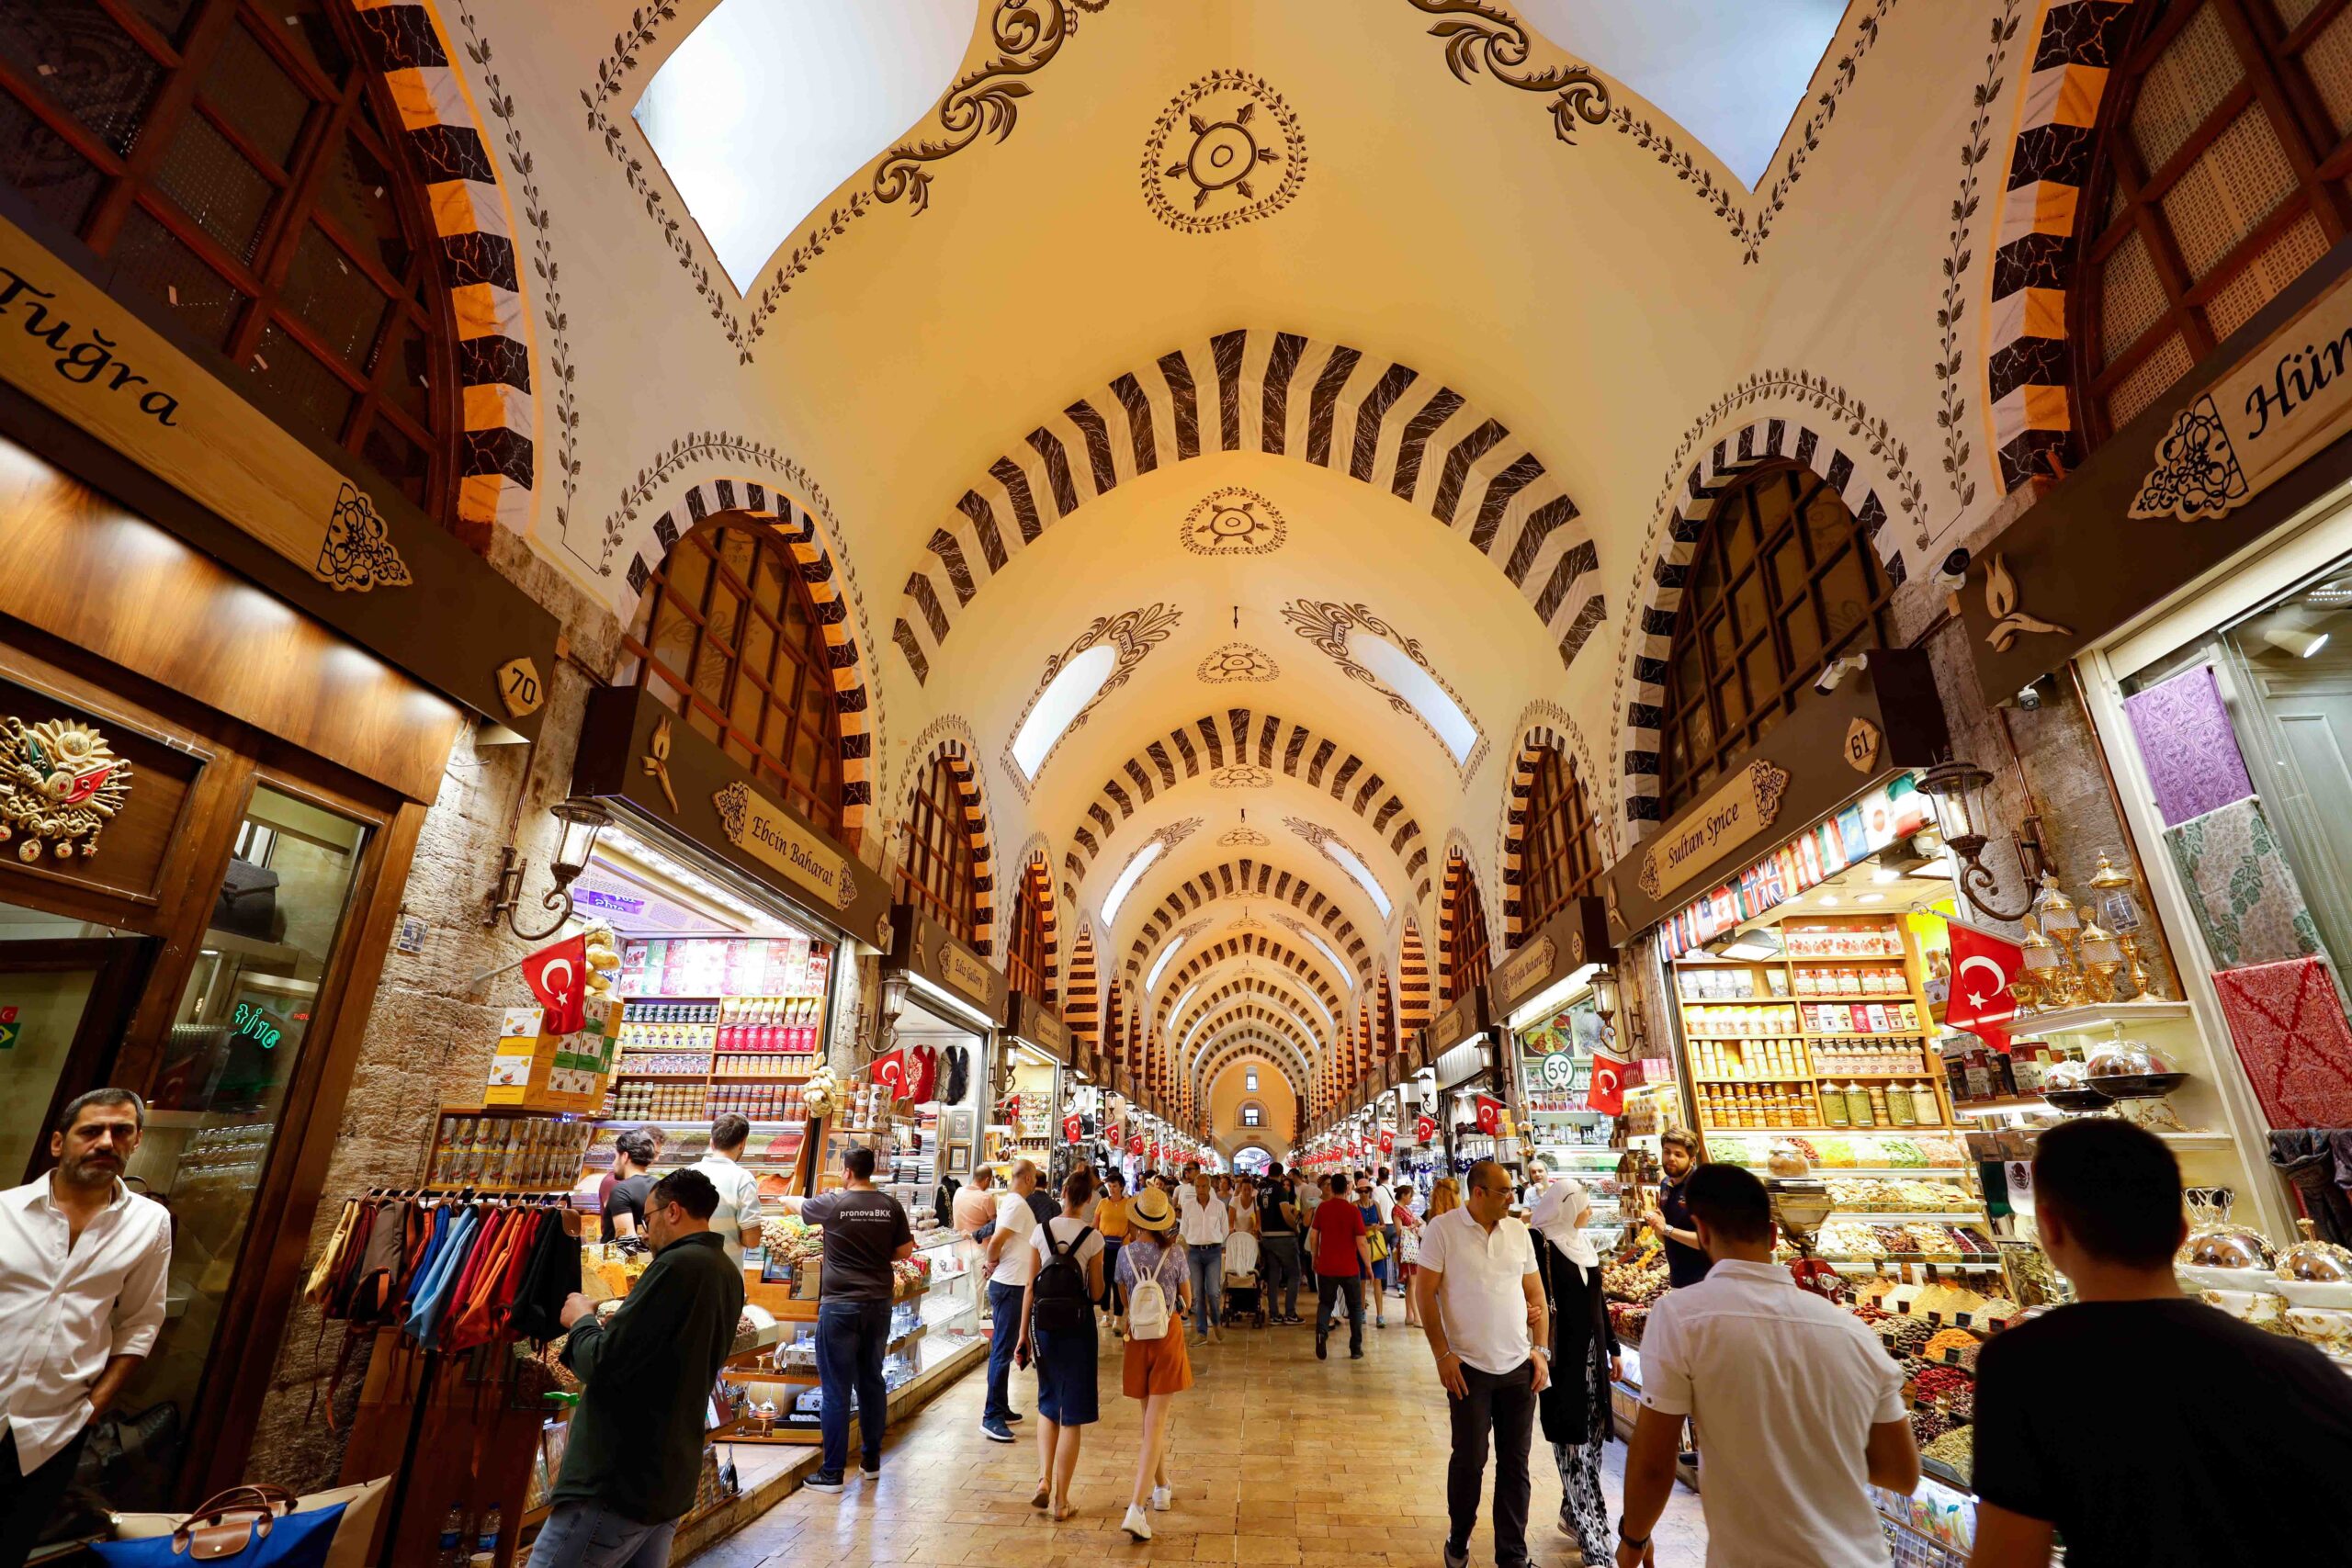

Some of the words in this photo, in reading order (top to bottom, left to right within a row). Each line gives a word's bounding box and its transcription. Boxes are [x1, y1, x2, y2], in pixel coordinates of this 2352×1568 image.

[508, 671, 537, 705] 70
[1850, 729, 1871, 760] 61
[752, 816, 787, 856] Ebcin
[789, 842, 835, 887] Baharat
[1668, 827, 1705, 869] Sultan
[1706, 802, 1740, 847] Spice
[1573, 938, 1581, 953] 59
[1548, 1061, 1568, 1079] 59
